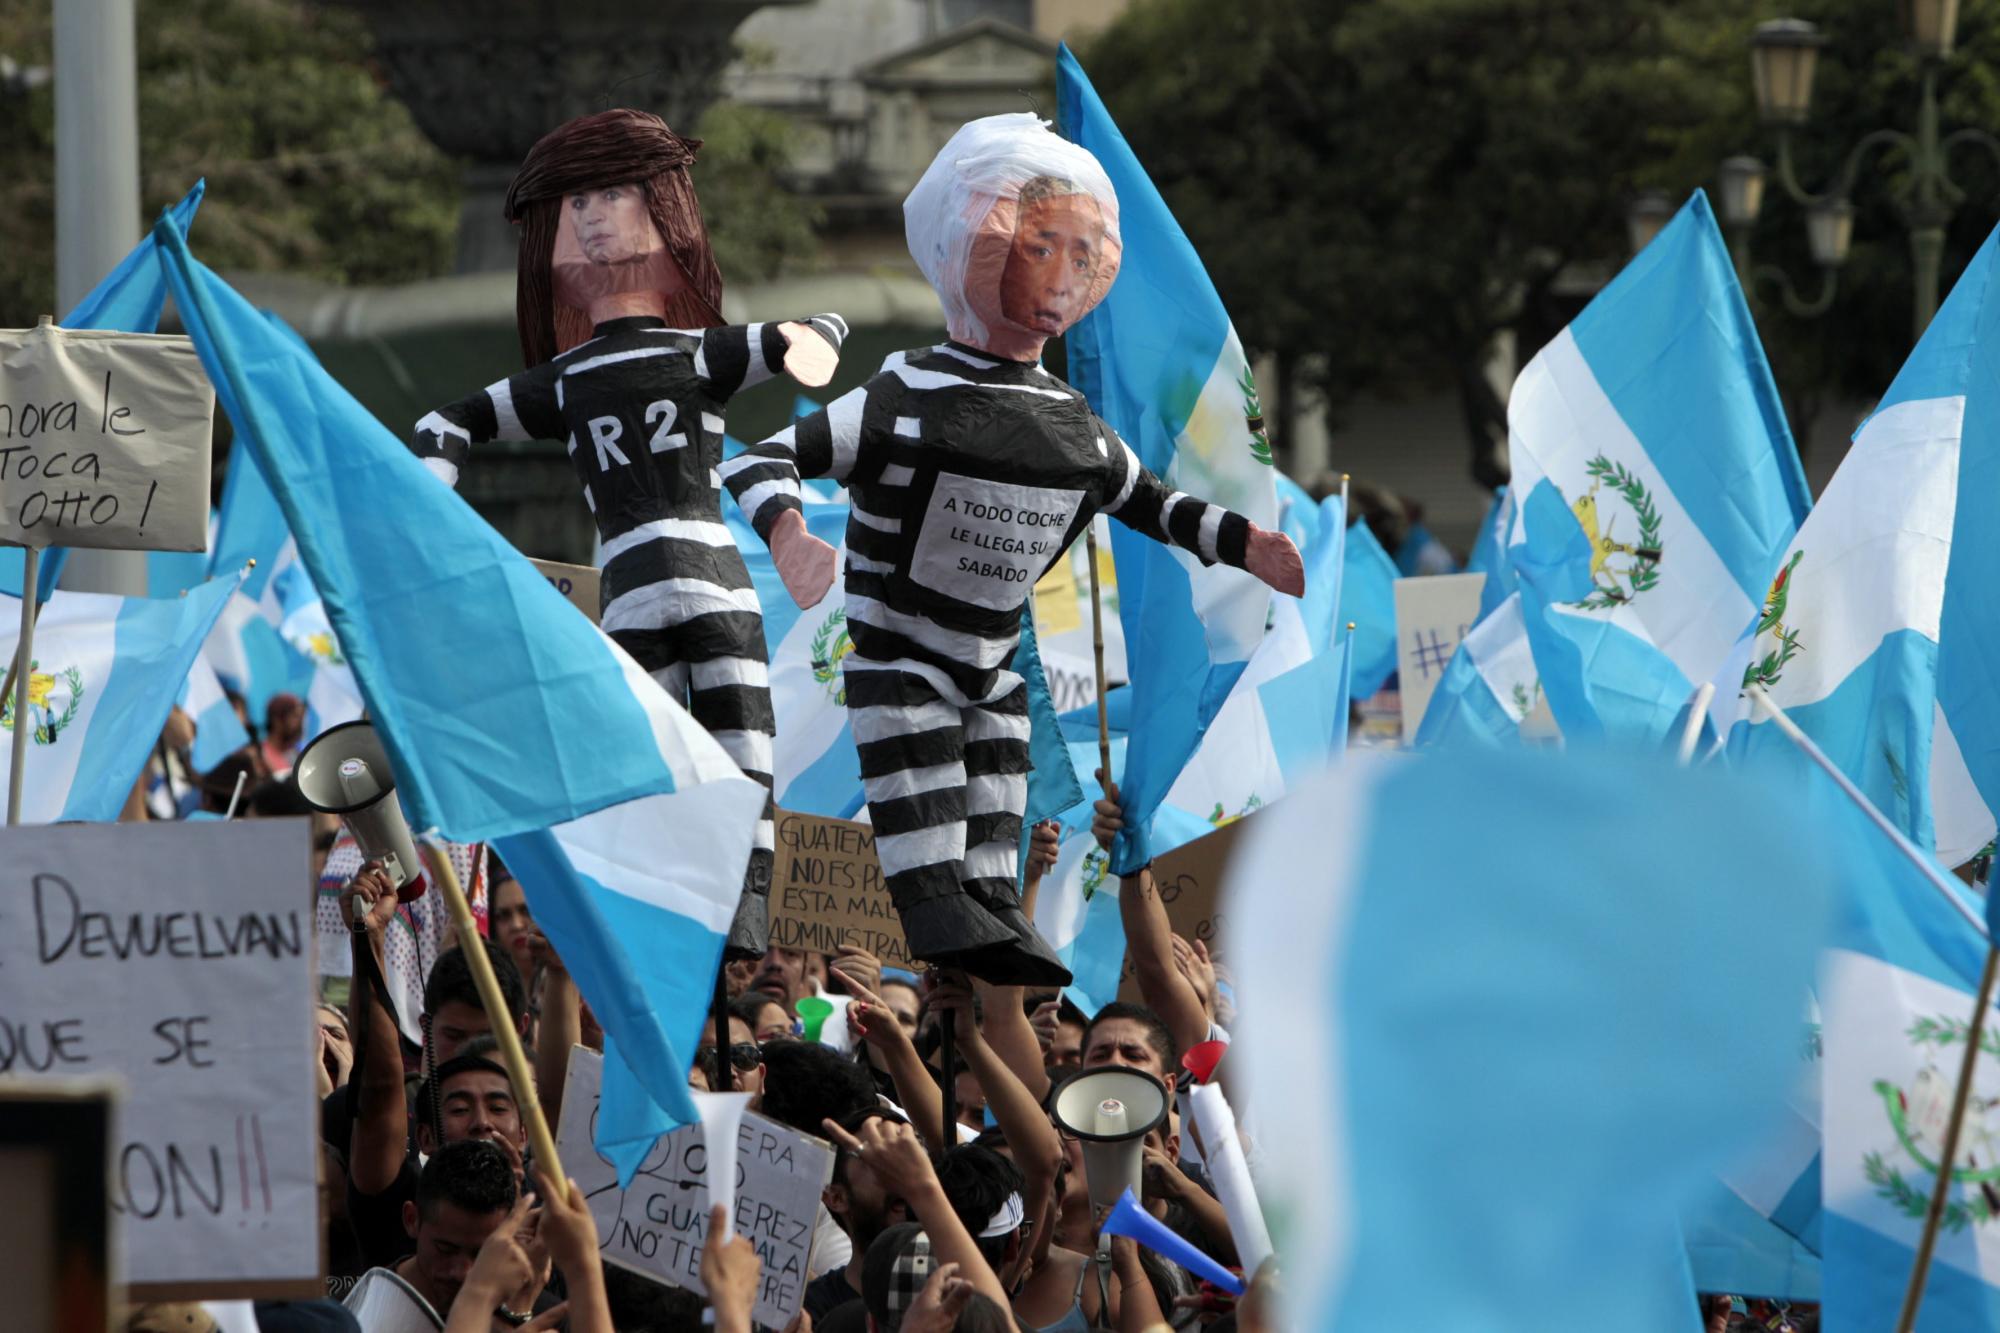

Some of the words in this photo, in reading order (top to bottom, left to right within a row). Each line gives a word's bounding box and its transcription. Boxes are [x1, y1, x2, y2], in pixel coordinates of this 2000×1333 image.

[102, 370, 146, 436] le
[943, 497, 957, 513] A
[964, 500, 1013, 524] TODO
[1016, 510, 1068, 527] COCHE
[950, 526, 971, 543] LE
[973, 532, 1026, 555] LLEGA
[1029, 540, 1049, 555] SU
[956, 556, 1029, 583] SABADO
[778, 816, 878, 857] GUATEM
[791, 857, 825, 885] NO
[828, 860, 856, 889] ES
[783, 887, 838, 913] ESTA
[846, 897, 899, 921] MAL
[152, 1015, 215, 1068] SE
[734, 1194, 808, 1250] EREZ
[670, 1235, 705, 1277] TE
